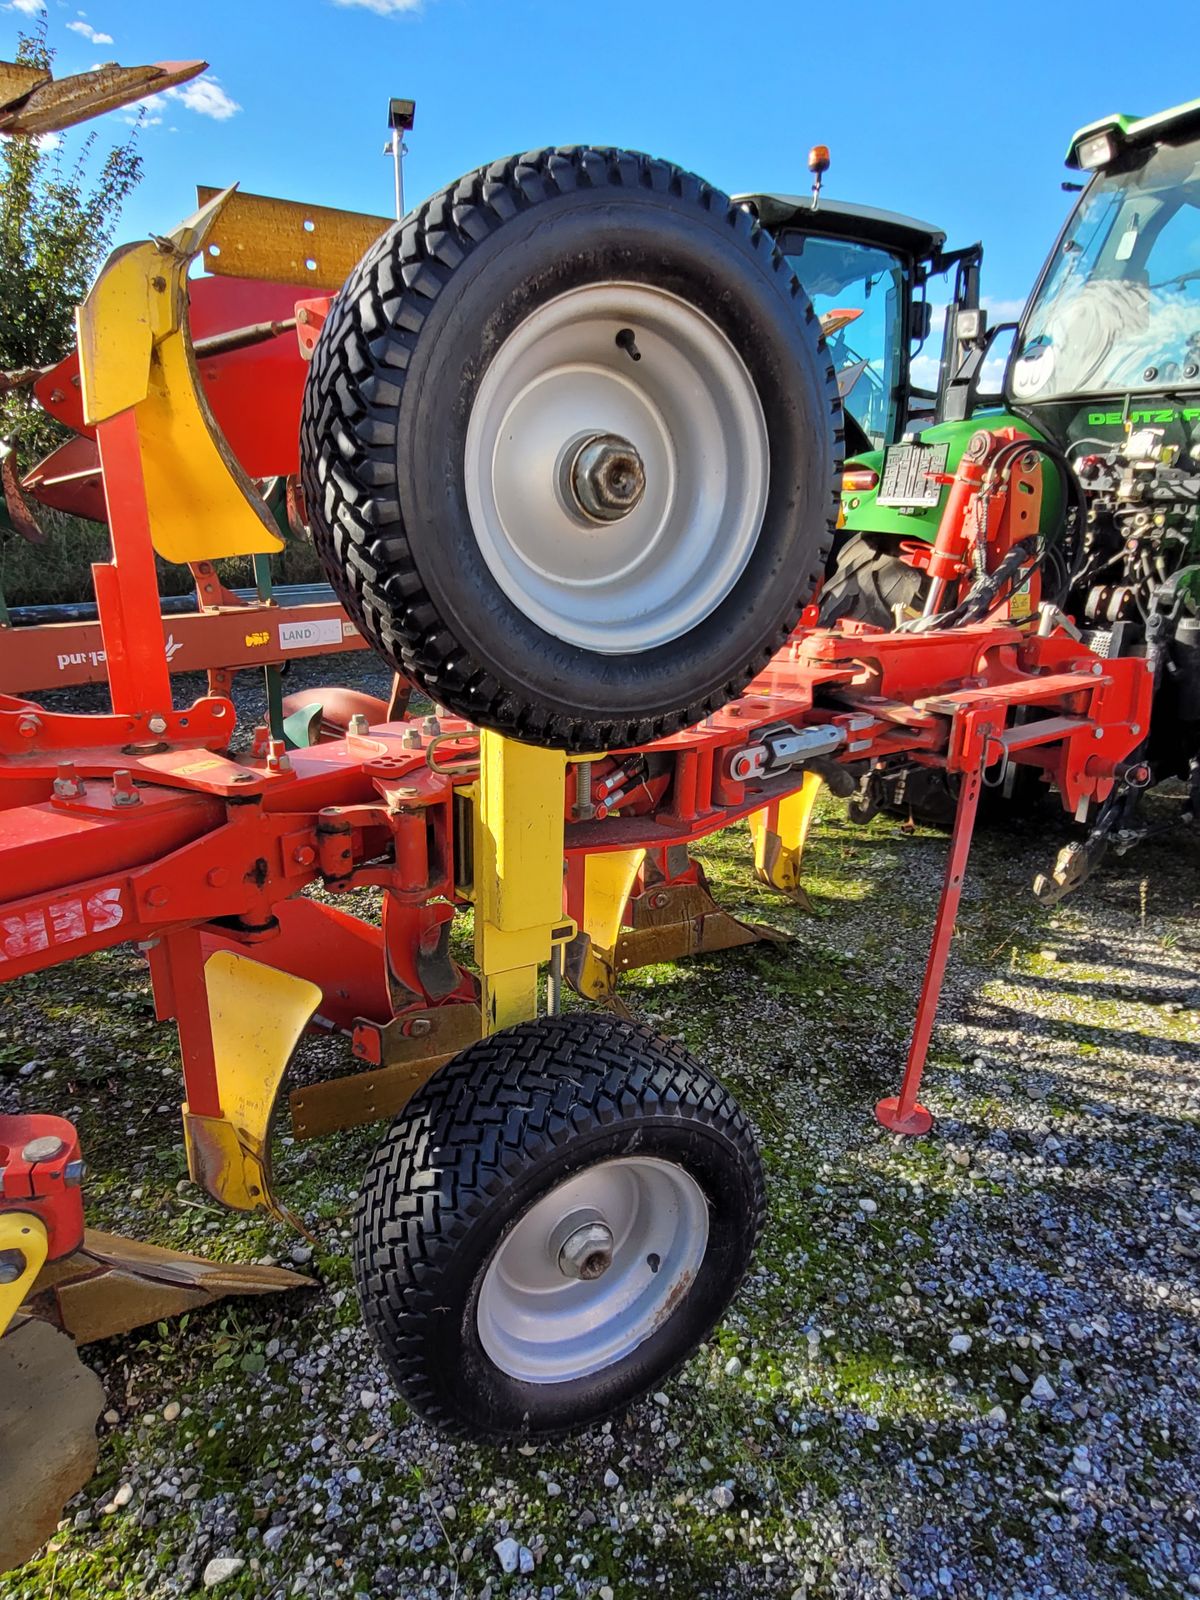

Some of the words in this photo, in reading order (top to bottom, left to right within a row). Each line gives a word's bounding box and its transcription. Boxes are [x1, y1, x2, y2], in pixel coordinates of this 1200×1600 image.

[1088, 408, 1200, 425] DEUTZ-F
[282, 628, 312, 641] LAND
[0, 888, 123, 960] SER
